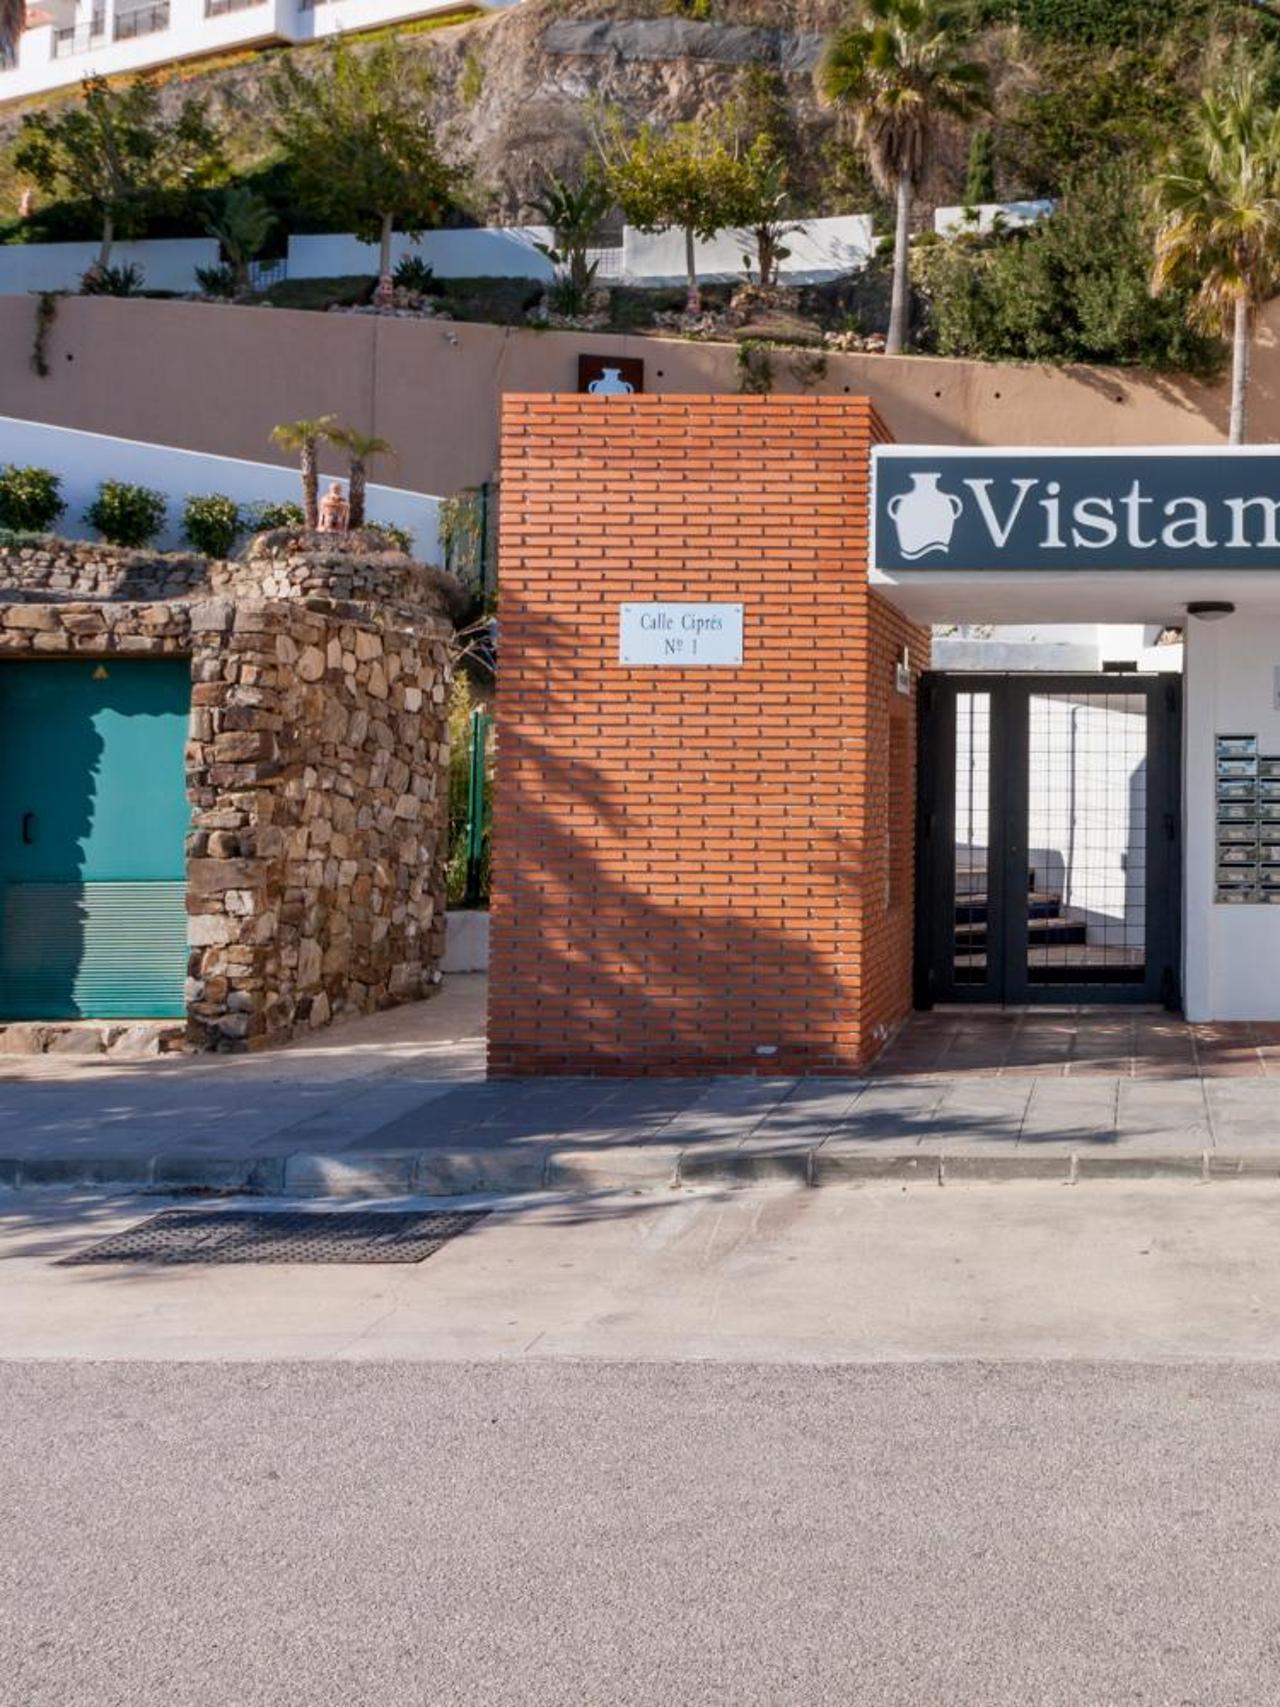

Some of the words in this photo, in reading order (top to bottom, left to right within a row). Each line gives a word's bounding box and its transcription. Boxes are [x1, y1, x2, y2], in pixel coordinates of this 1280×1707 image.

[640, 613, 673, 630] Calle
[682, 612, 723, 635] Ciprés
[691, 639, 697, 655] 1
